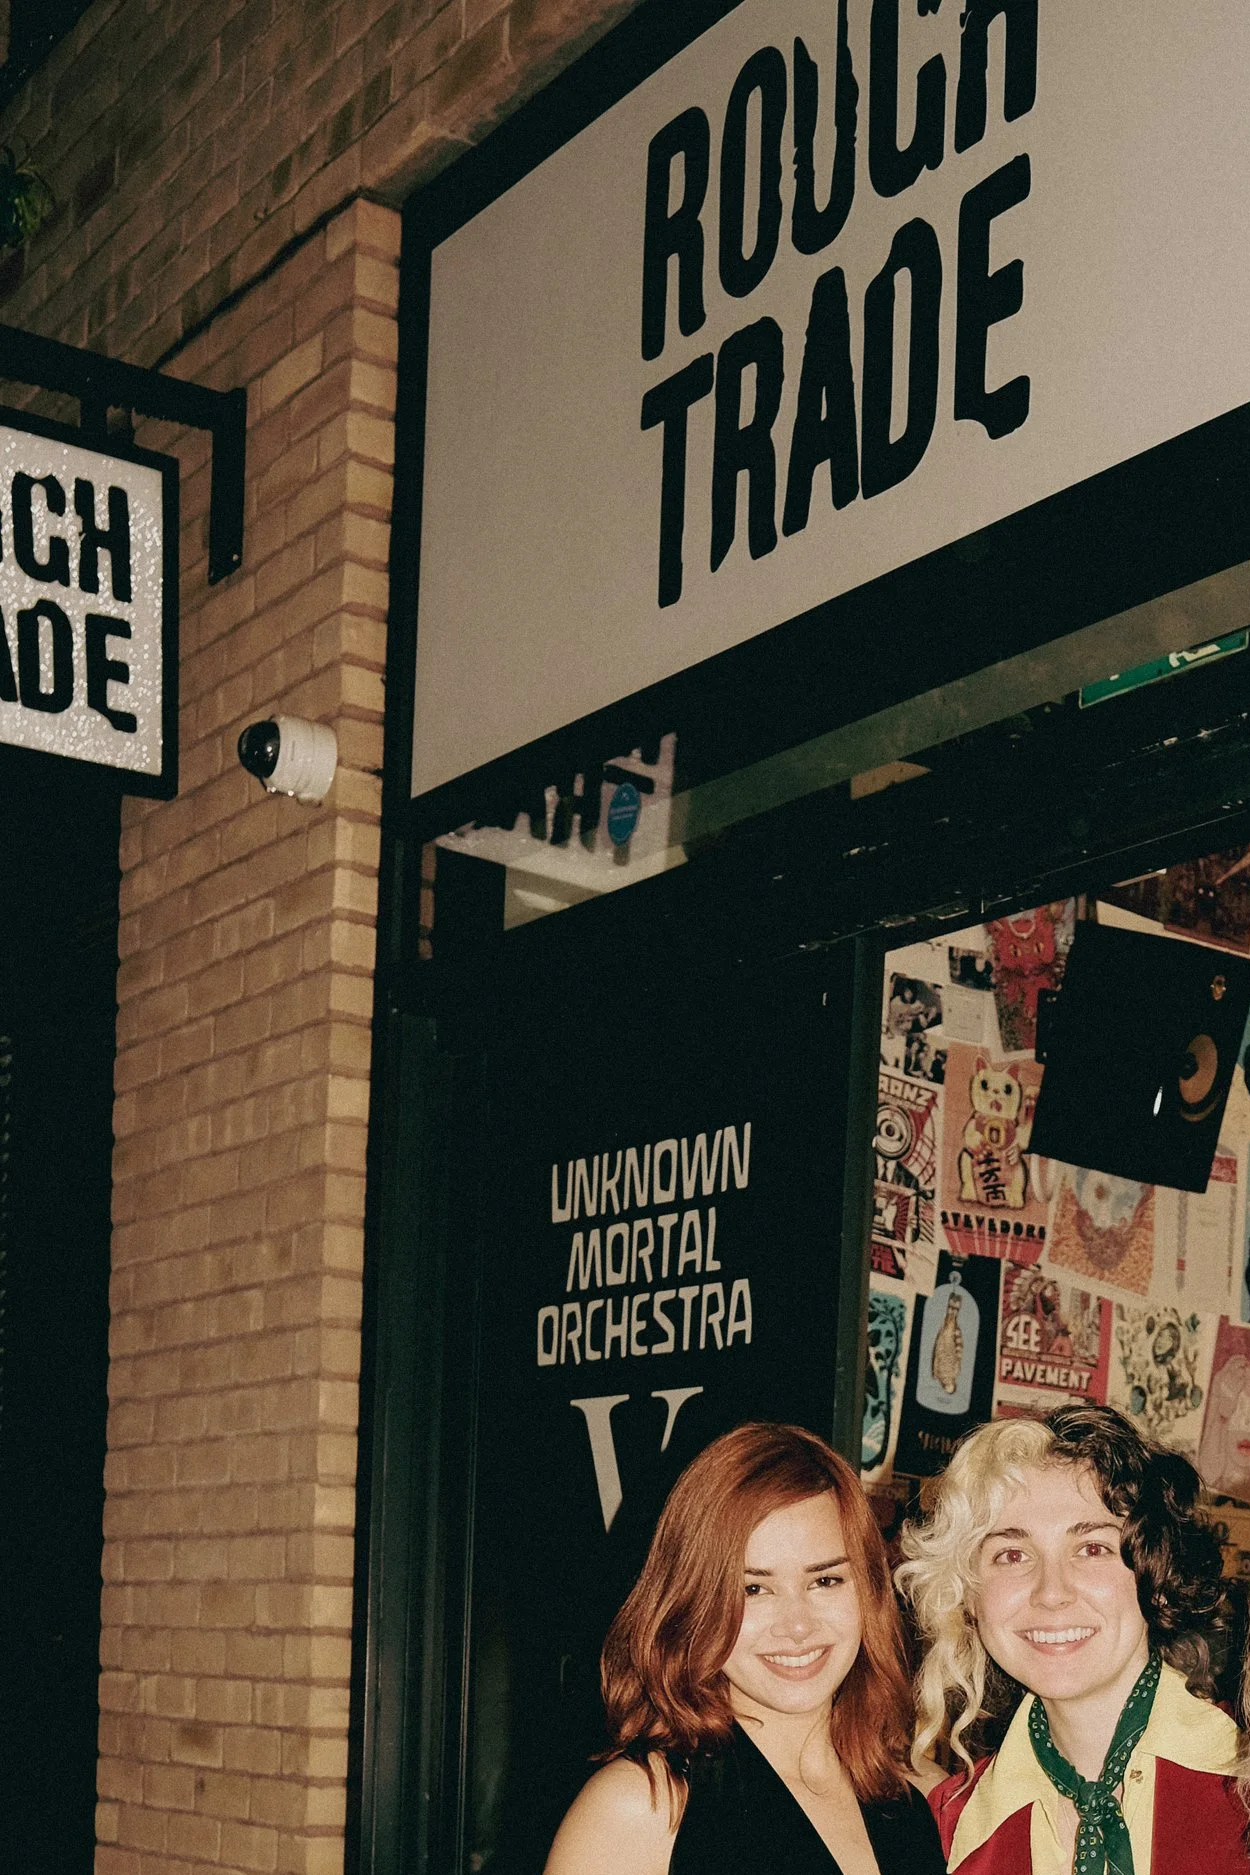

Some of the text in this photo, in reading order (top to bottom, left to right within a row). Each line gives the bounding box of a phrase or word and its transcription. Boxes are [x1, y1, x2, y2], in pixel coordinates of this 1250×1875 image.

[642, 0, 1039, 361] ROUGH
[641, 153, 1031, 608] TRADE
[0, 471, 132, 604] GH
[551, 1122, 752, 1223] UNKNOWN
[566, 1207, 721, 1292] MORTAL
[537, 1278, 752, 1367] ORCHESTRA
[1005, 1314, 1041, 1352] SEE
[1001, 1358, 1091, 1391] PAVEMENT
